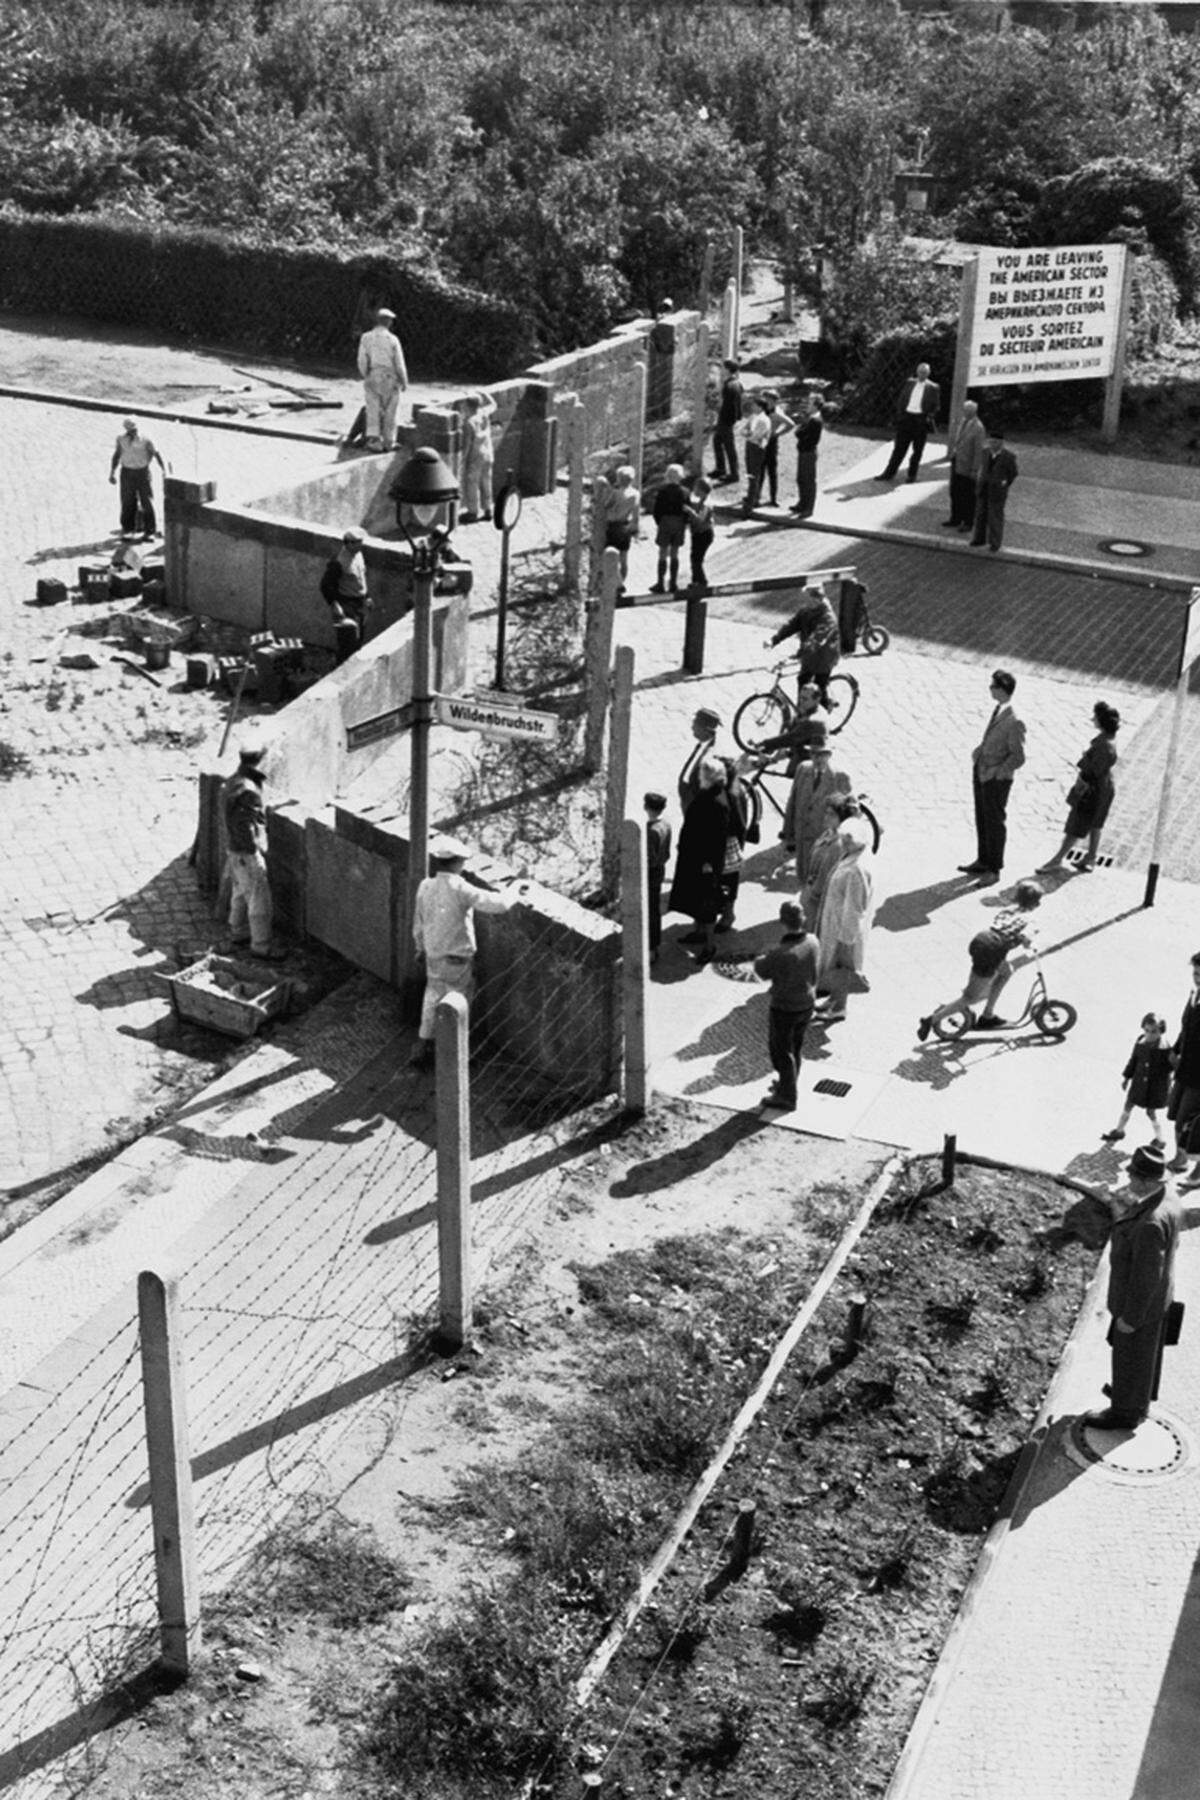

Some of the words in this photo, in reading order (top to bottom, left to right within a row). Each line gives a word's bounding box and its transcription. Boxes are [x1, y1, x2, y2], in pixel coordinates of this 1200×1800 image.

[997, 255, 1020, 268] YOU
[1026, 253, 1050, 266] ARE
[1055, 250, 1103, 265] LEAVING
[990, 271, 1008, 284] THE
[1012, 269, 1065, 283] AMERICAN
[1069, 265, 1108, 280] SECTOR
[989, 291, 1008, 305] ВЫ
[1013, 286, 1082, 303] ВЫЕЗЖАЕТЕ
[1002, 324, 1034, 339] VOUS
[1040, 321, 1084, 337] SORTEZ
[980, 343, 994, 356] DU
[998, 340, 1045, 355] SECTEUR
[1048, 336, 1104, 351] AMERICAIN
[450, 705, 546, 734] Wildenbruchstr.
